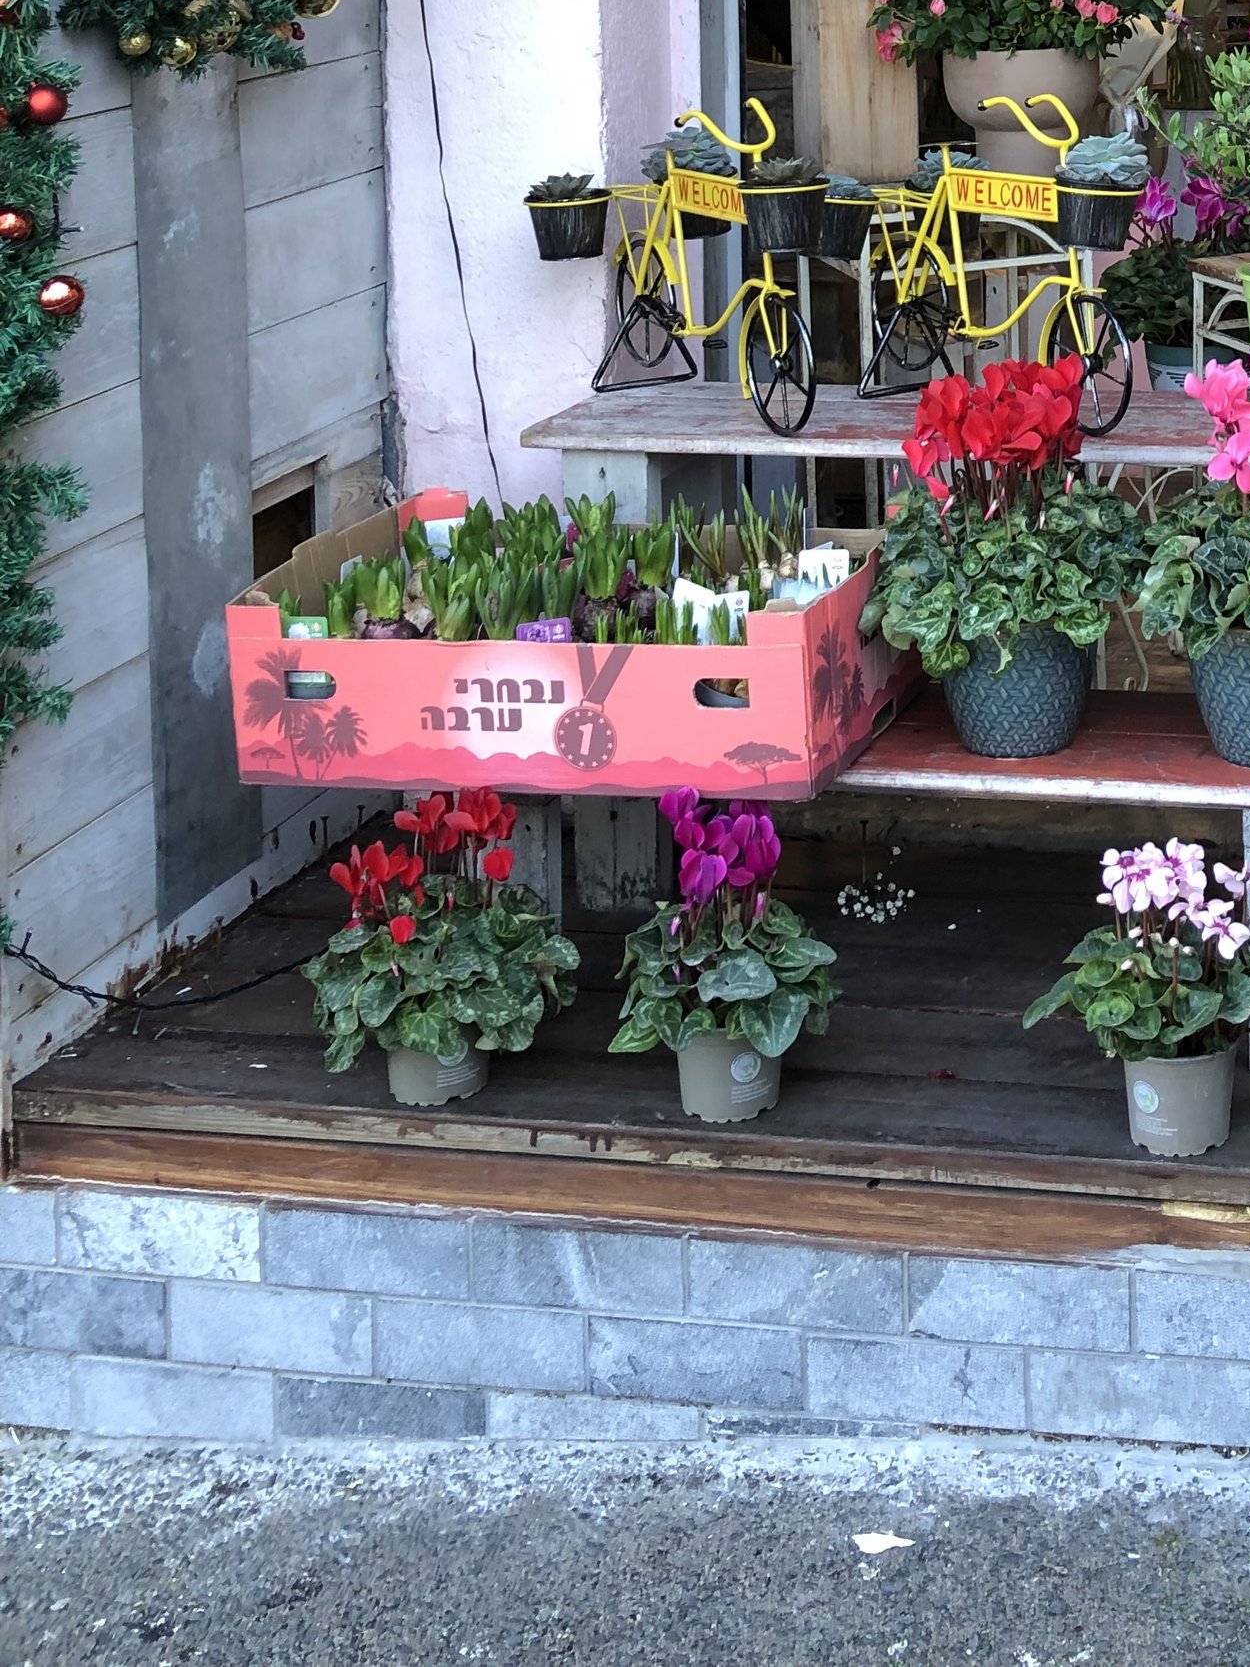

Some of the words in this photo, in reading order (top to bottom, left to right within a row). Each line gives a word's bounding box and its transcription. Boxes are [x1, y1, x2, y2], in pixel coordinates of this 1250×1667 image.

[679, 177, 741, 213] WELCOM
[956, 177, 1052, 212] WELCOME
[453, 677, 566, 704] נבחרי
[420, 705, 523, 732] ערבה
[578, 722, 594, 756] 1
